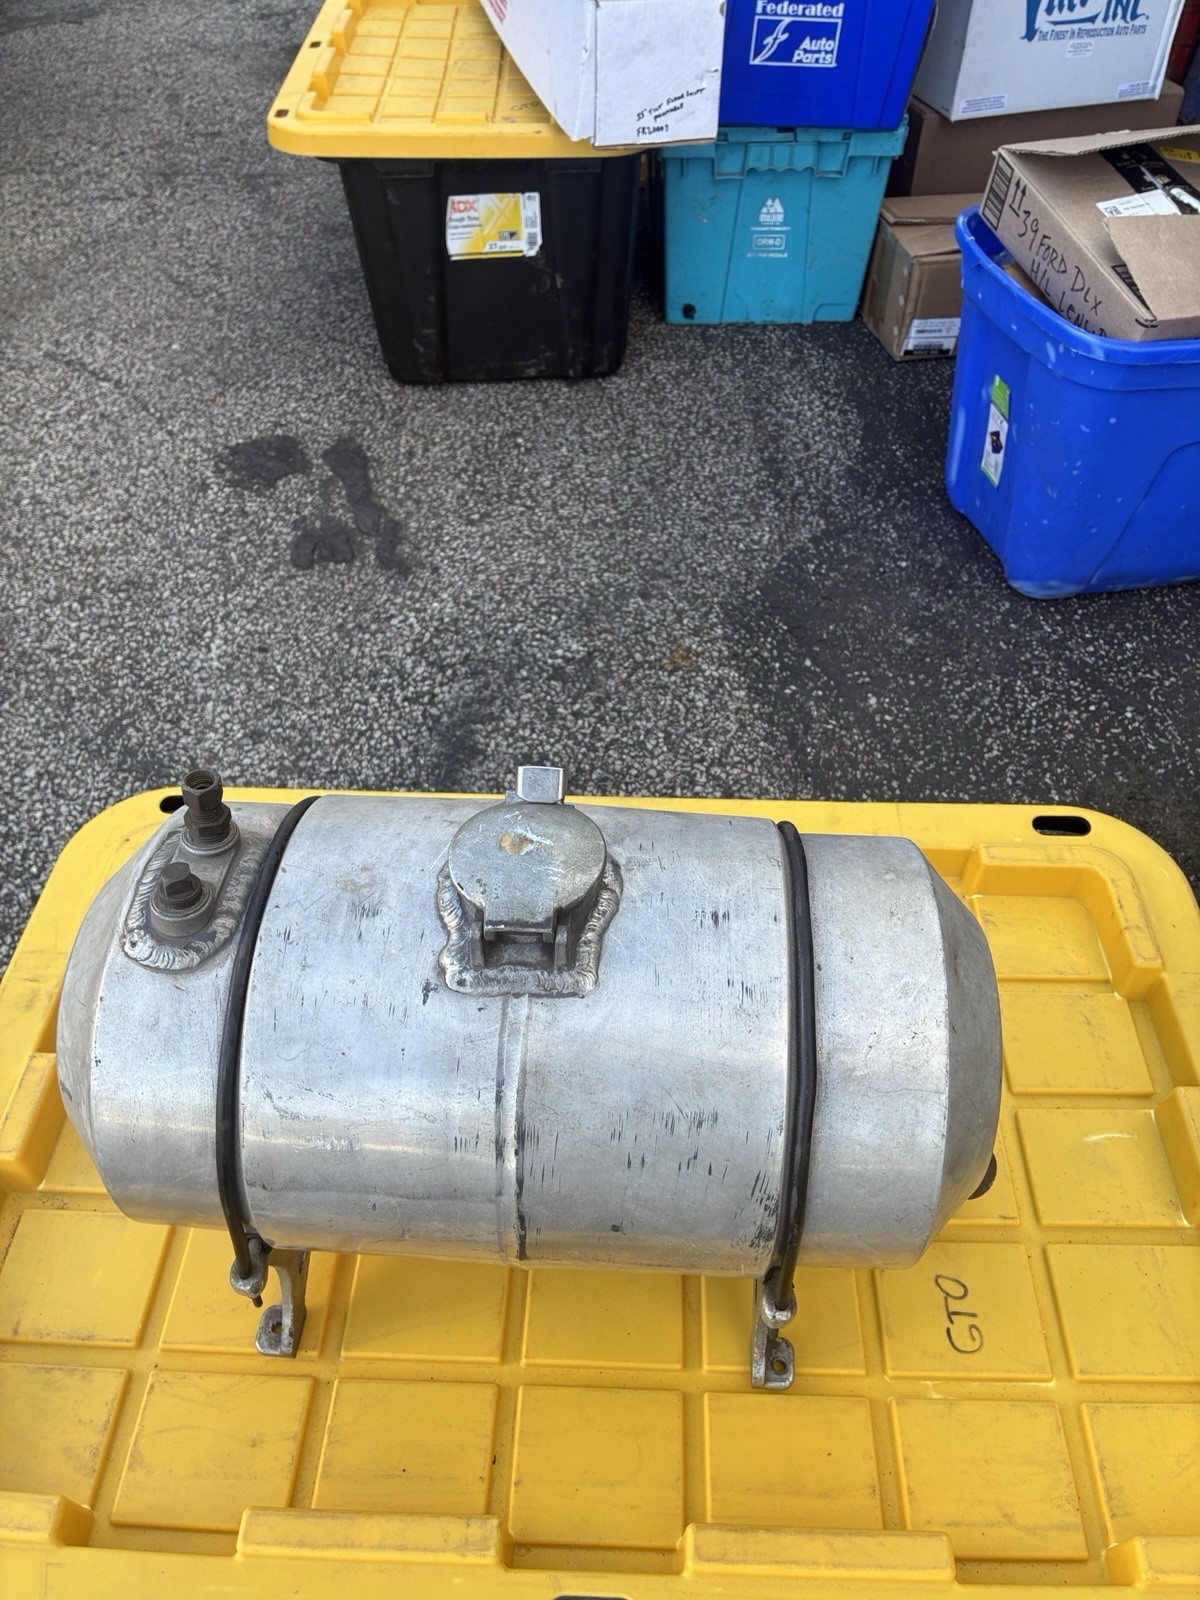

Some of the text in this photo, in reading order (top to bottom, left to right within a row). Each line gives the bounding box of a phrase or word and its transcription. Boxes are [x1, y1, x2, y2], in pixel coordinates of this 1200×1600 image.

[756, 0, 845, 17] Federated
[800, 36, 835, 51] Auto
[792, 50, 833, 64] Parts
[1018, 210, 1040, 250] 39
[935, 1274, 983, 1354] GTO
